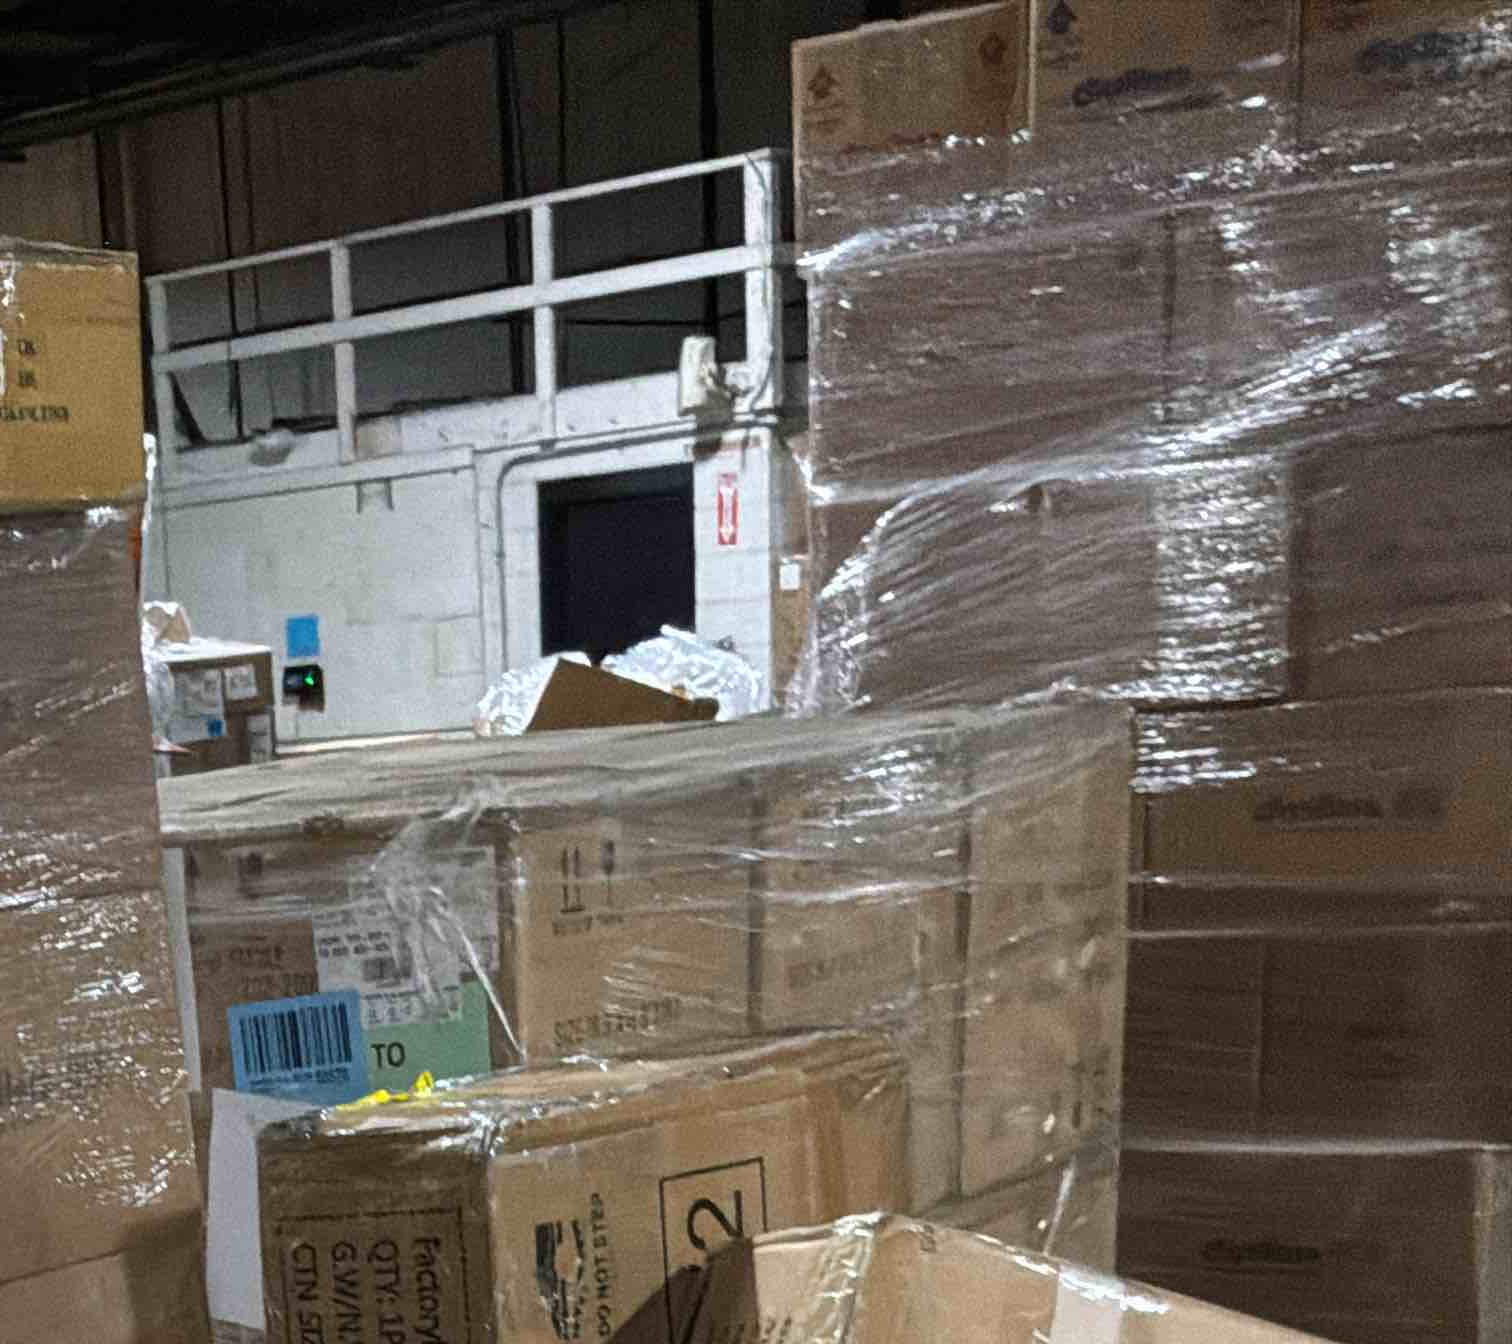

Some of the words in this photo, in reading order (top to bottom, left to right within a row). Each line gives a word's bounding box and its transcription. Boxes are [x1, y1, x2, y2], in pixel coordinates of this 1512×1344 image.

[370, 1042, 407, 1068] TO
[292, 1242, 319, 1301] CTN
[366, 1239, 399, 1304] QTY:
